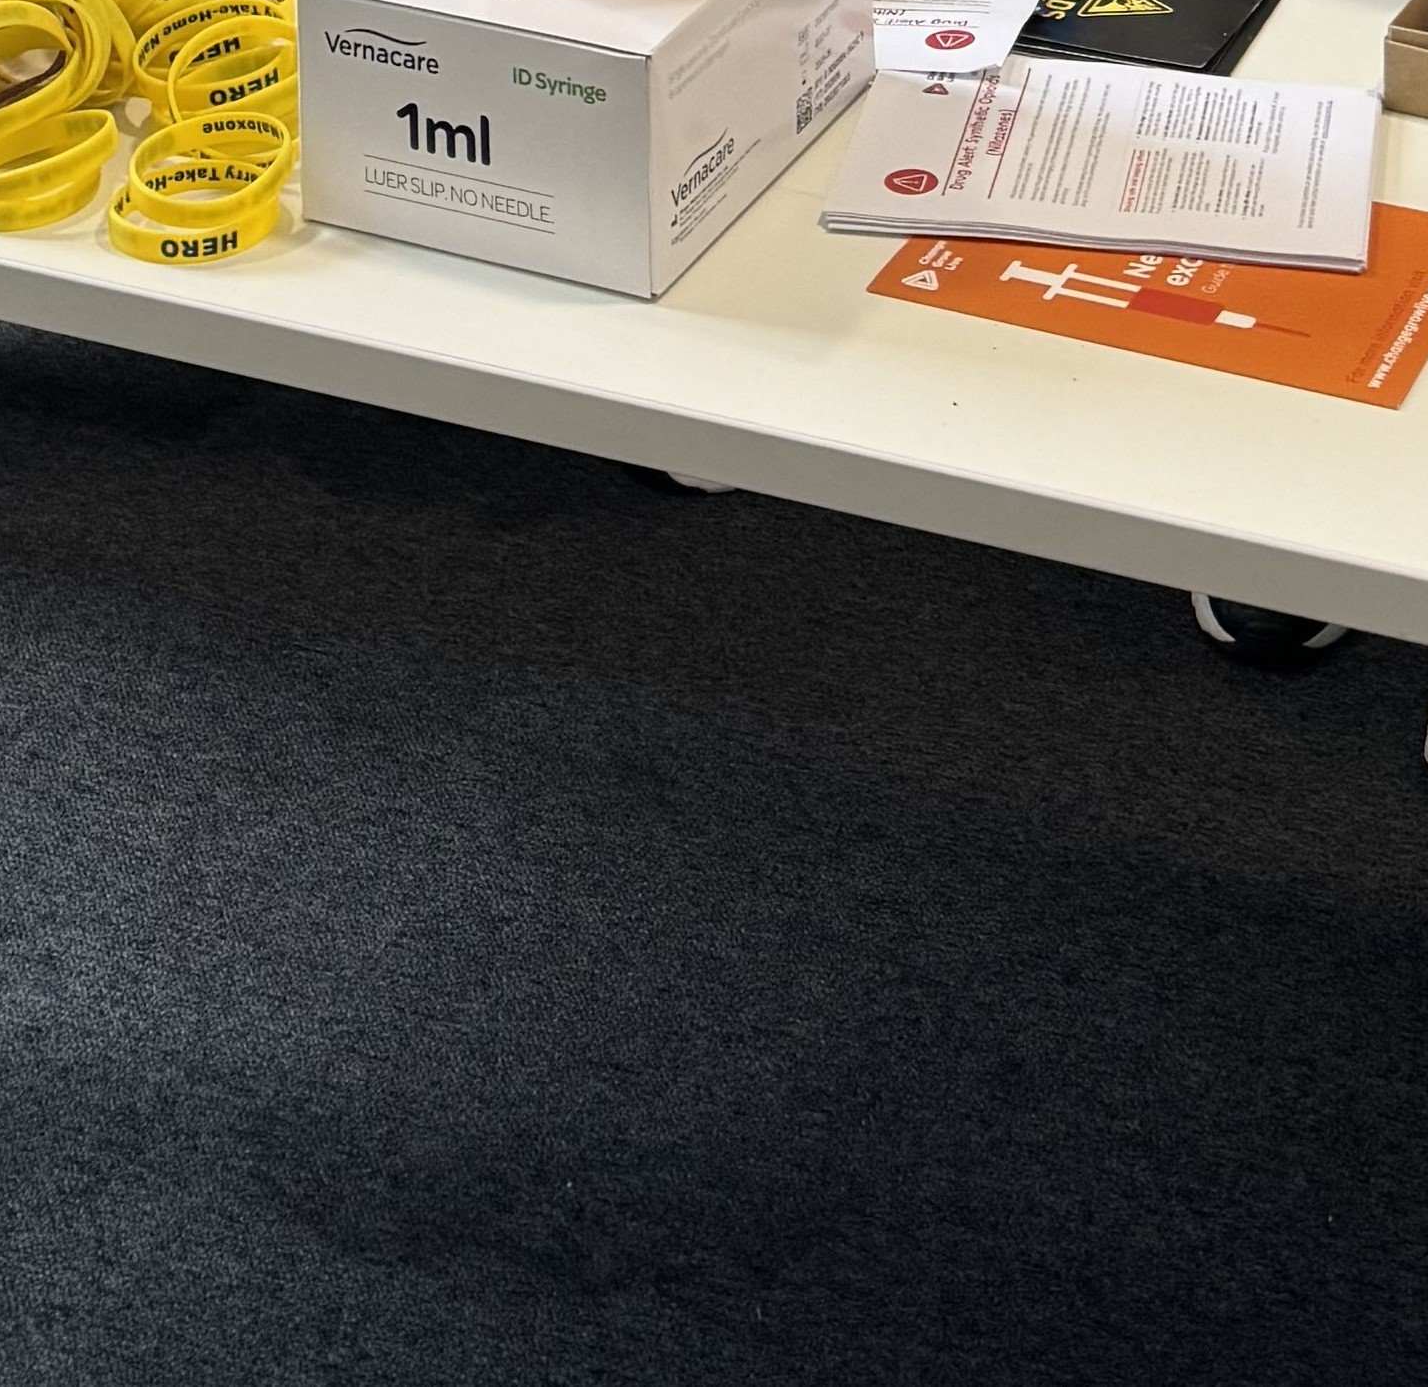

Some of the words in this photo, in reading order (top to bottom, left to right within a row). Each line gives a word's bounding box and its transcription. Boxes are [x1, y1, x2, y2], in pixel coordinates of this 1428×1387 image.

[162, 4, 261, 37] Take-Home
[324, 30, 440, 76] Vernacare
[209, 67, 280, 107] HERO
[512, 66, 533, 87] ID
[534, 71, 608, 105] Syringe
[395, 101, 493, 167] 1ml
[671, 137, 735, 207] Vernacare
[958, 145, 975, 168] Alert
[365, 166, 408, 192] LUER
[450, 186, 478, 207] NO
[949, 168, 972, 191] Drug
[160, 230, 239, 258] HERO
